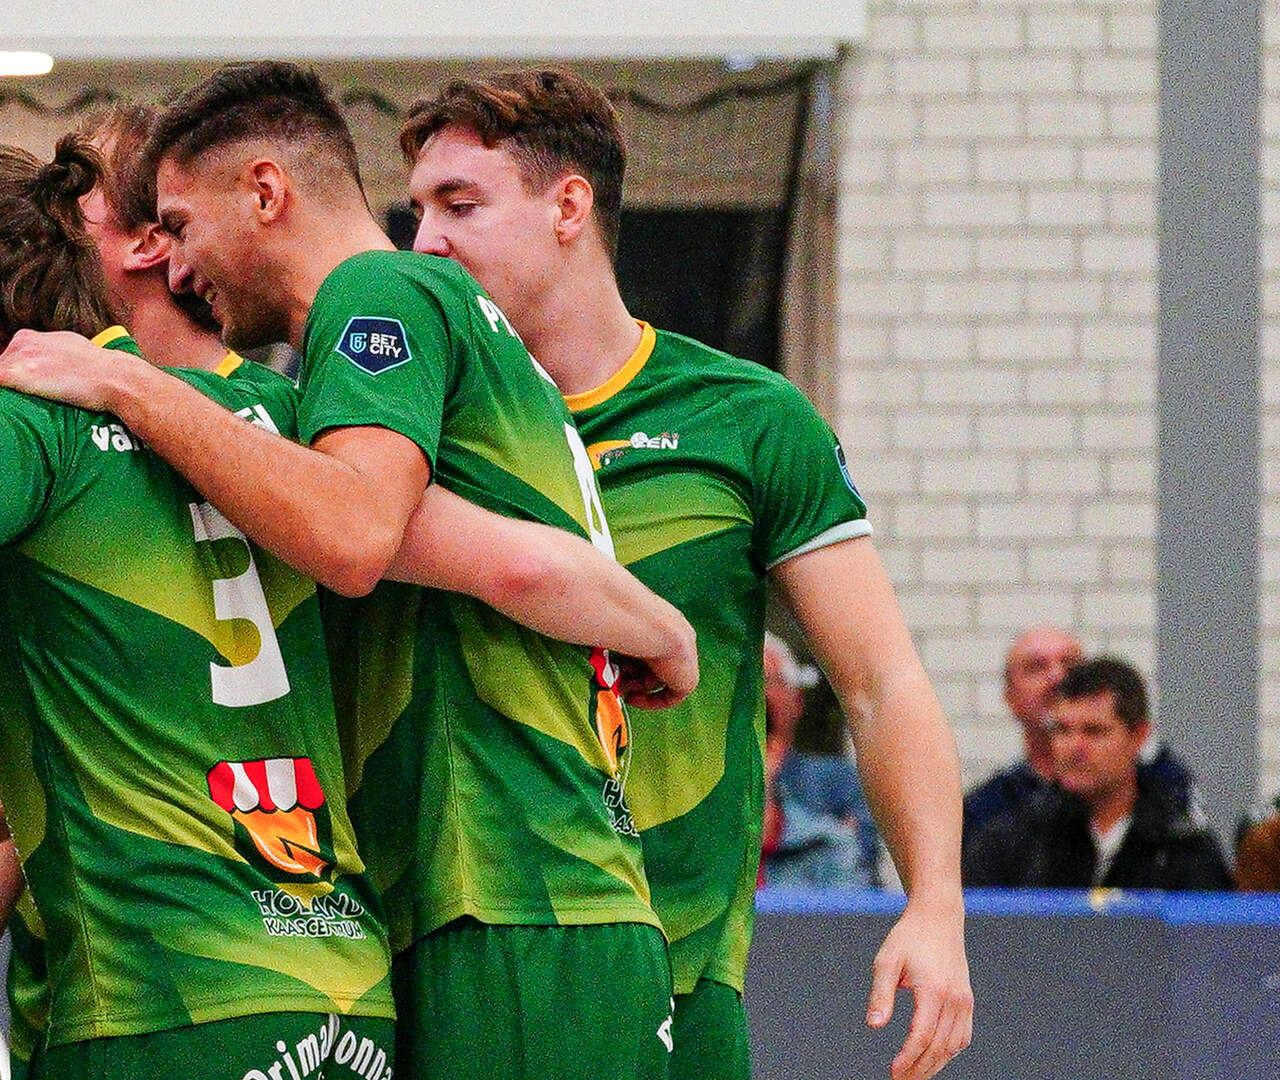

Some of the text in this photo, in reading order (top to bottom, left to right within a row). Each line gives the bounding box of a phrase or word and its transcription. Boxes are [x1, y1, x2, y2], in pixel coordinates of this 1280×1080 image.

[370, 333, 398, 346] BET
[369, 343, 402, 358] CITY
[189, 501, 291, 708] 3
